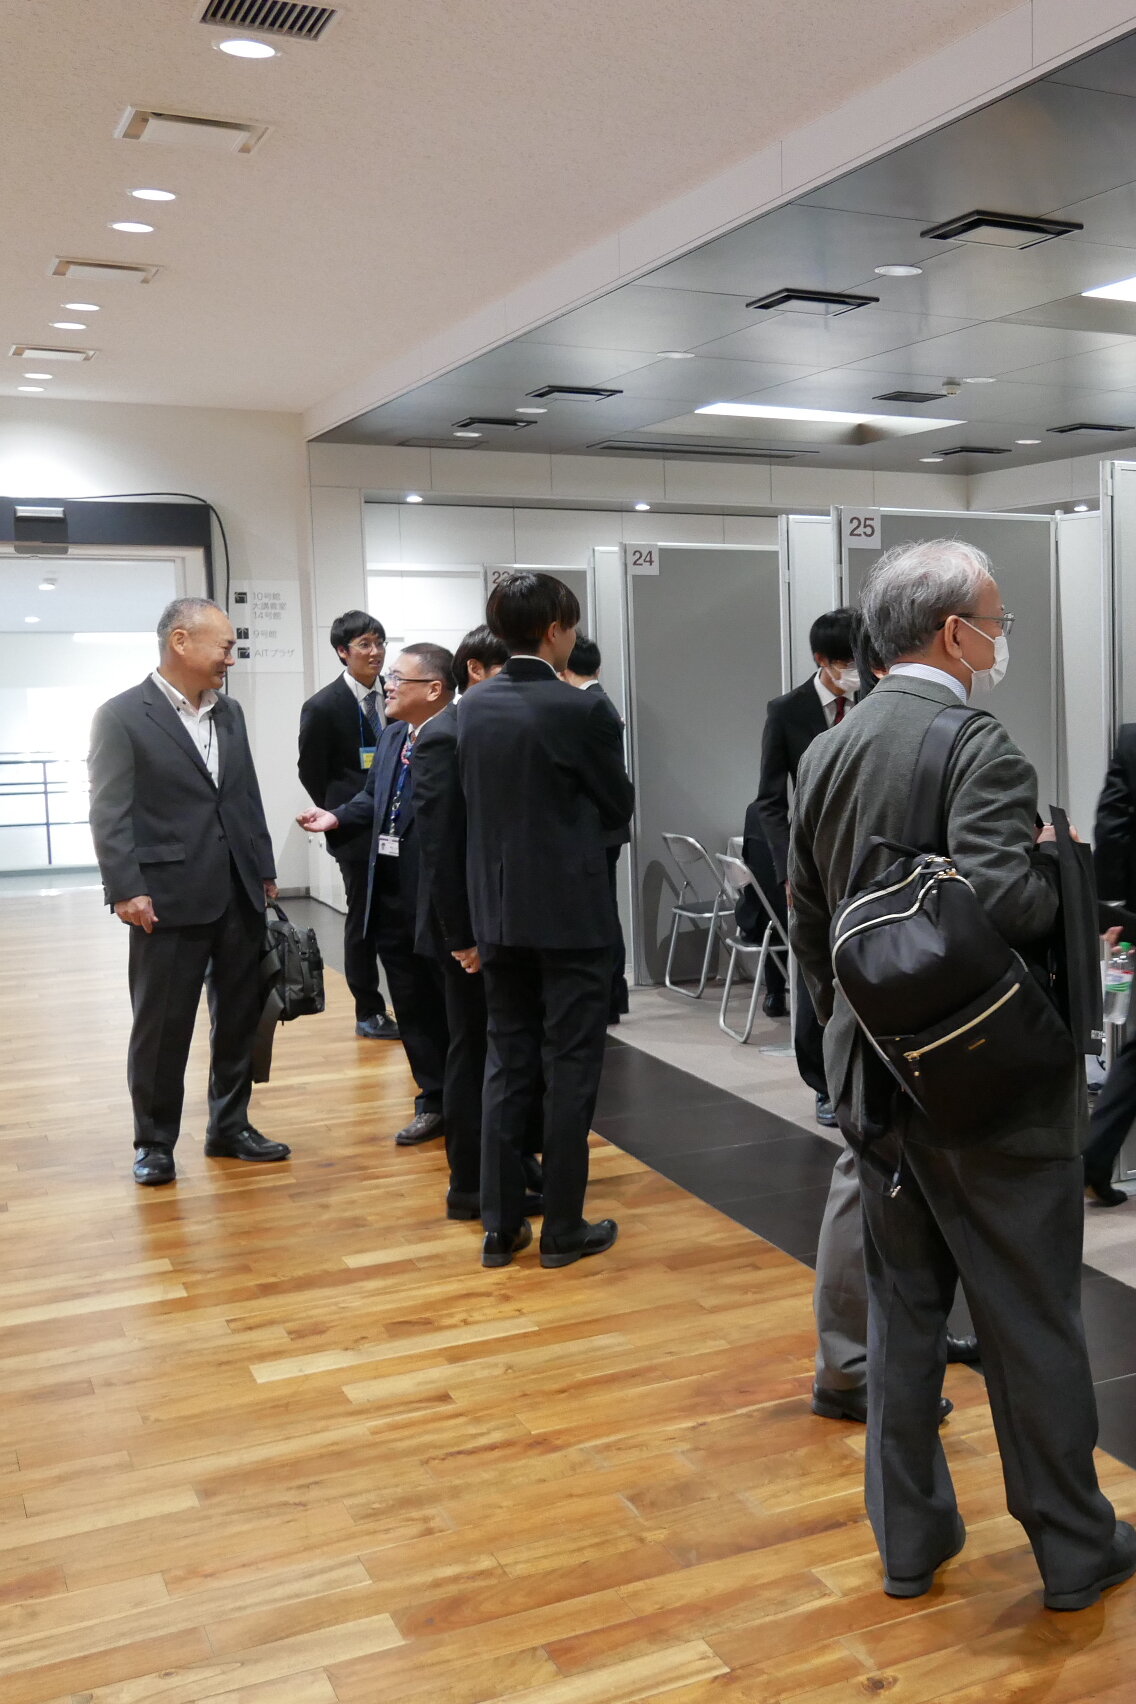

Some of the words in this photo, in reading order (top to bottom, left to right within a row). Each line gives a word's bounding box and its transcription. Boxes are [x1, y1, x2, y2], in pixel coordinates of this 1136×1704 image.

[849, 516, 876, 538] 25
[632, 550, 655, 567] 24
[253, 592, 281, 601] 10号館
